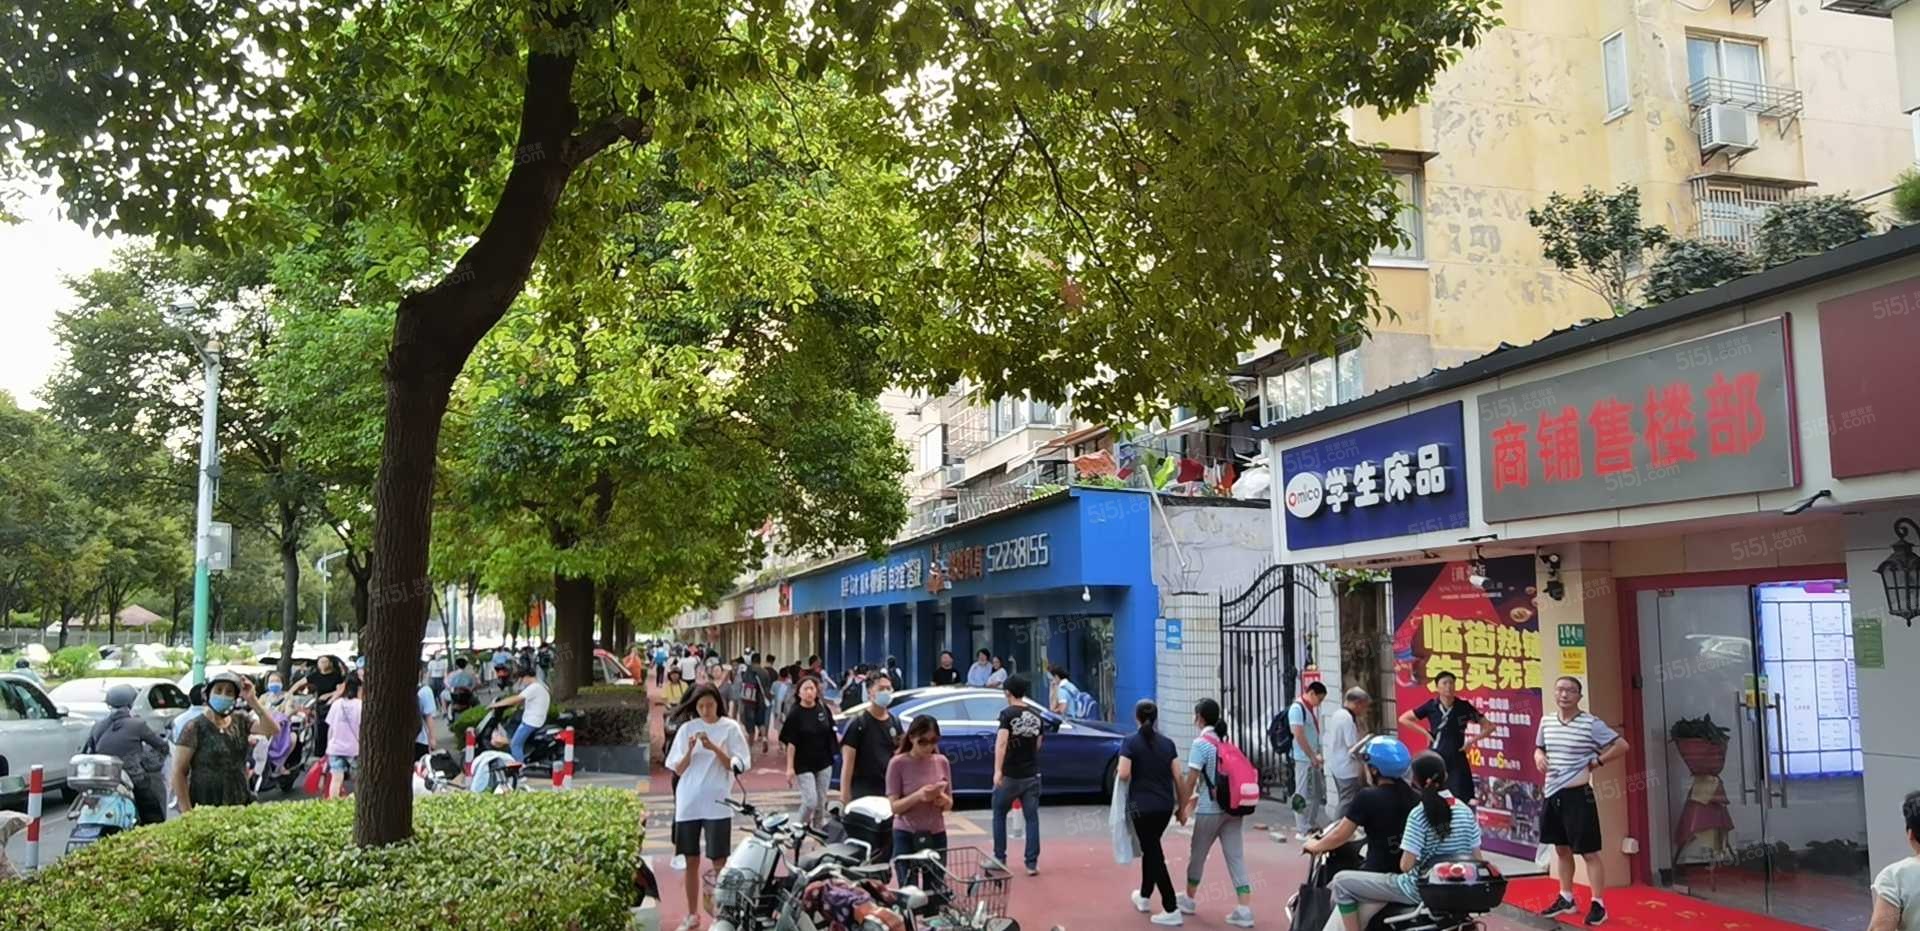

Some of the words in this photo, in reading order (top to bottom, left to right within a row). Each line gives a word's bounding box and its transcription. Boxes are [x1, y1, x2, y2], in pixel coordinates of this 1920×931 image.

[1490, 370, 1766, 493] 商铺售楼部
[1324, 443, 1446, 513] 学生床品
[986, 533, 1049, 573] 52238155
